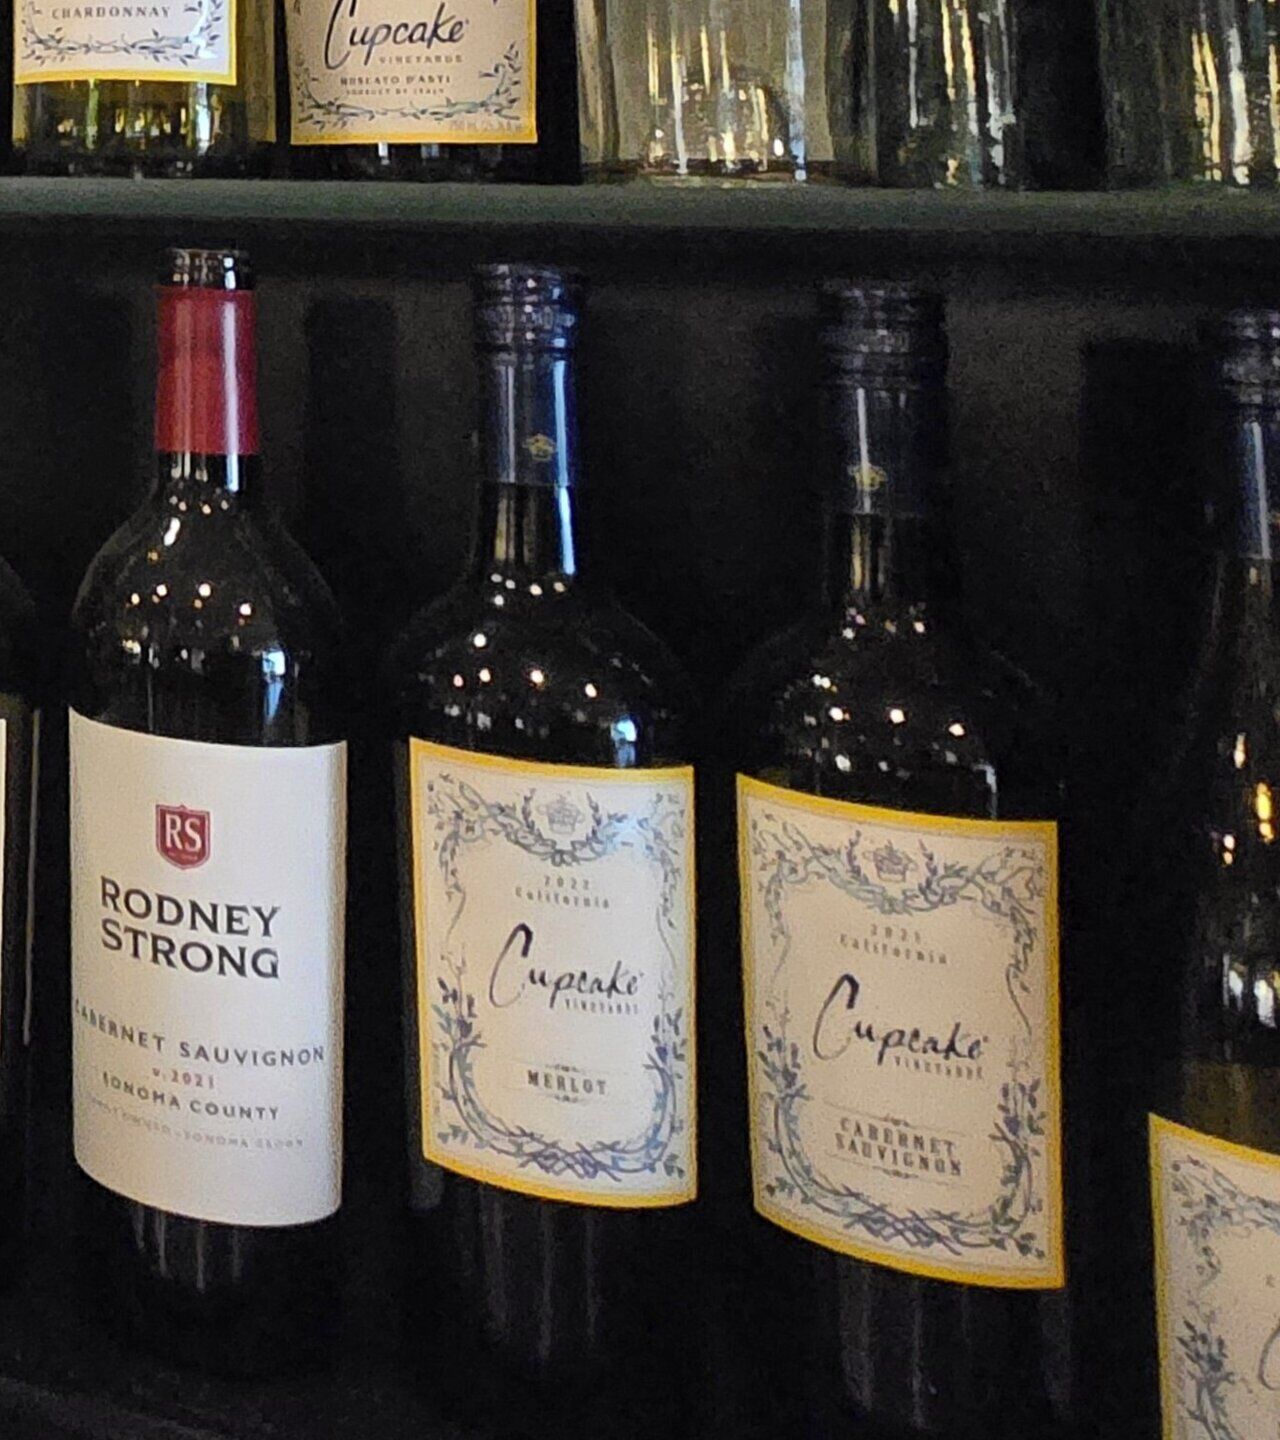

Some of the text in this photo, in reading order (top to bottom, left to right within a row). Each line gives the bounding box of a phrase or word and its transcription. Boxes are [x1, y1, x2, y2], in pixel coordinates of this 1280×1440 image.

[51, 5, 171, 20] CHARDONNAY
[340, 75, 401, 86] MOSCATO
[378, 54, 463, 65] VINEYARDS
[164, 813, 202, 853] RS
[101, 876, 282, 938] RODNEY
[101, 918, 280, 980] STRONG
[488, 922, 641, 1009] Cupcake
[75, 997, 326, 1067] CABERNET SAUVIGNON
[812, 972, 988, 1067] Cupcake
[102, 1070, 280, 1121] SONOMA COUNTY
[527, 1068, 608, 1096] MERLOT
[835, 1132, 964, 1177] SAUVIGNON
[839, 1117, 957, 1153] CABERNET
